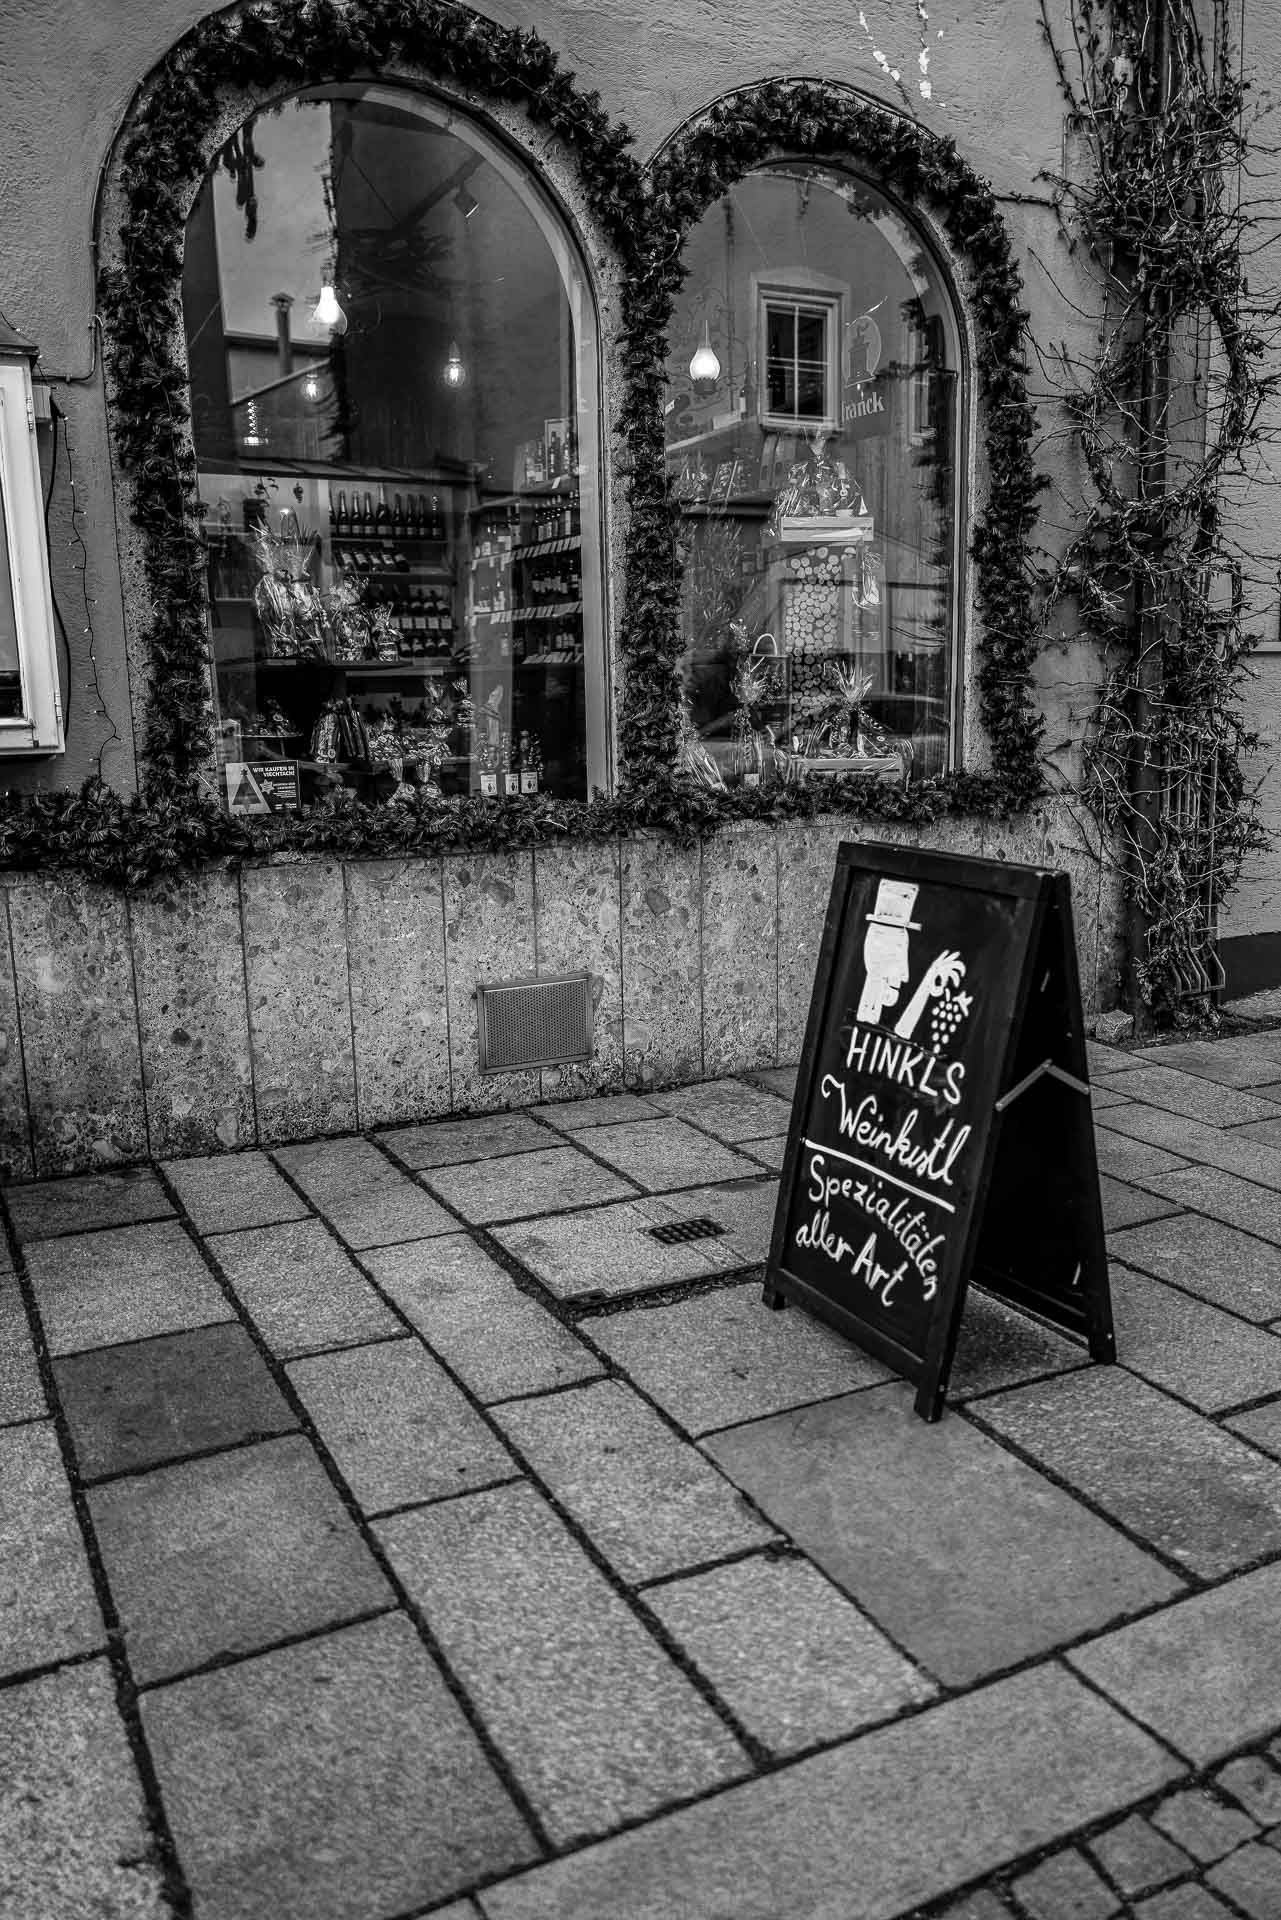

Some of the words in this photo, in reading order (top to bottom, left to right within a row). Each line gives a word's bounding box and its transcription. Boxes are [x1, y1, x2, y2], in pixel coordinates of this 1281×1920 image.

[846, 1026, 965, 1104] HINKLS
[796, 1210, 855, 1262] aller
[851, 1233, 909, 1306] Art
[809, 1154, 946, 1301] Spezialitäten
